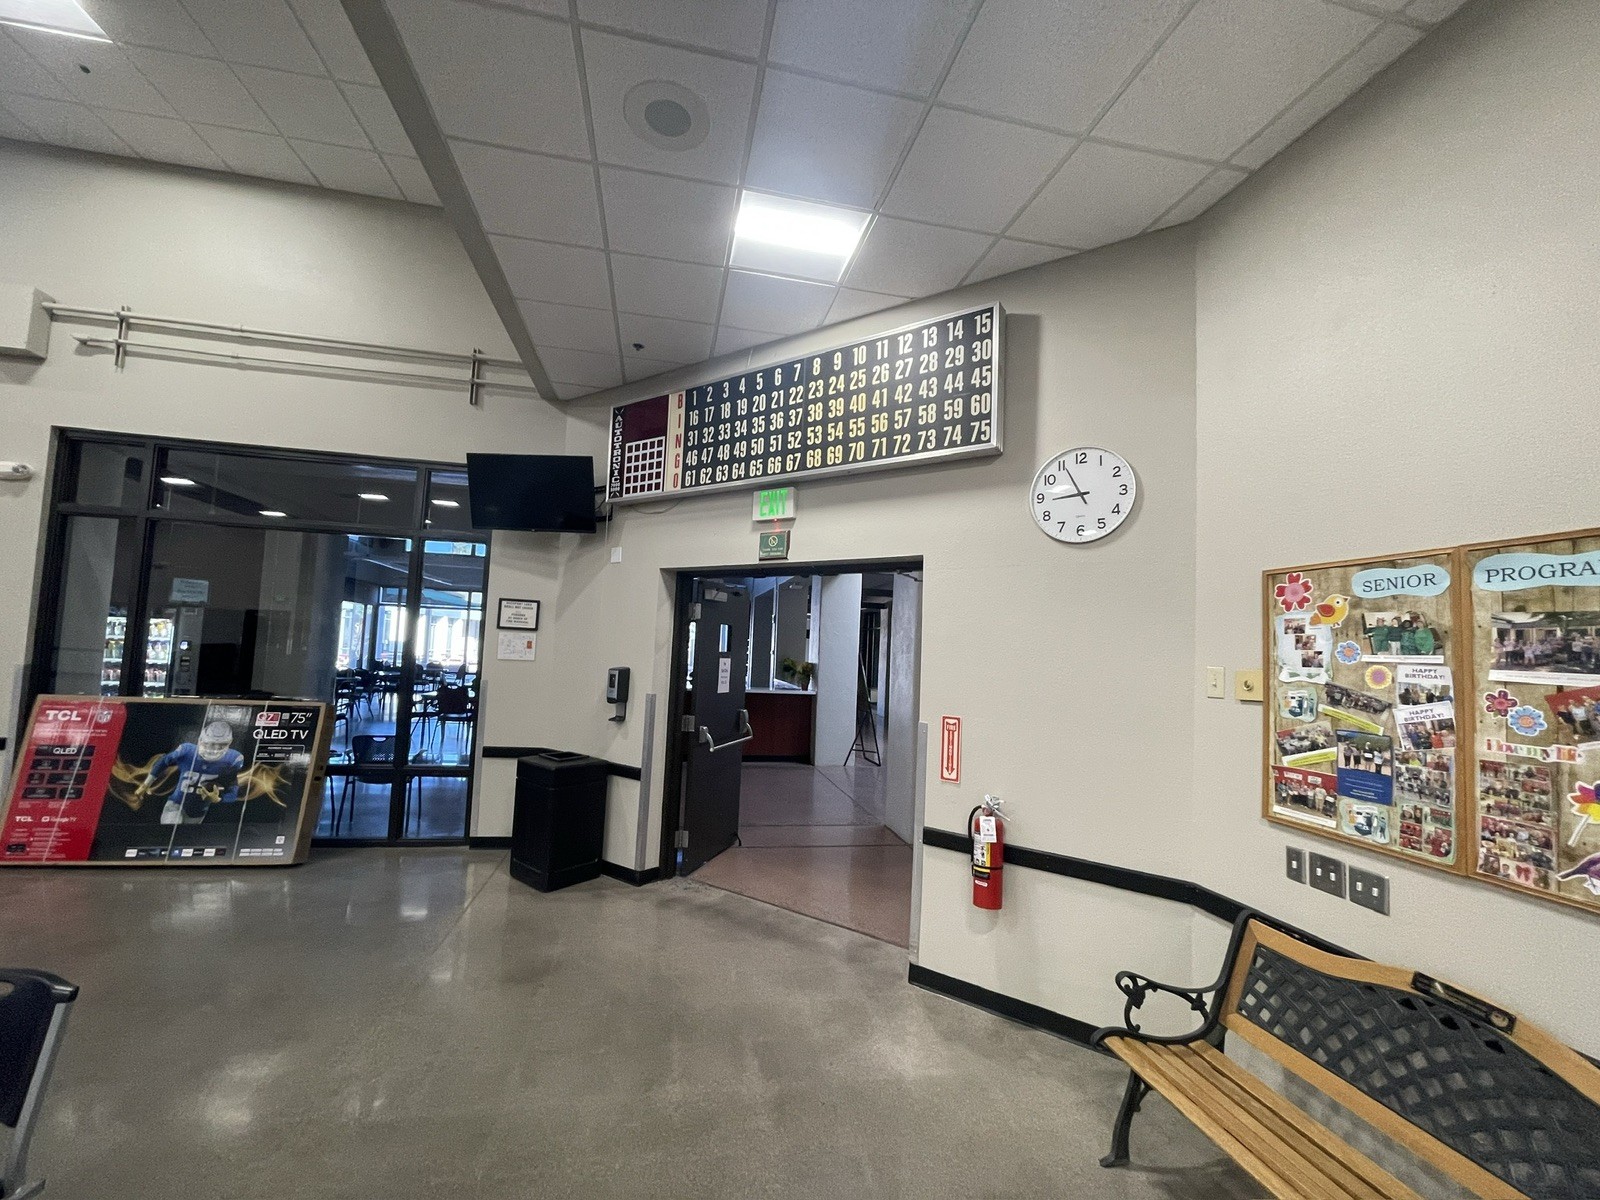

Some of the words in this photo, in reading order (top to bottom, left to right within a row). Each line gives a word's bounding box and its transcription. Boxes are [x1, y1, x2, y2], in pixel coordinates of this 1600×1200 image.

[693, 390, 697, 406] 1
[707, 386, 712, 402] 2
[723, 382, 728, 398] 3
[739, 378, 745, 393] 4
[756, 373, 762, 390] 5
[775, 368, 782, 386] 6
[794, 363, 801, 381] 7
[813, 358, 821, 376] 8
[834, 352, 842, 371] 9
[853, 345, 866, 365] 10
[876, 340, 888, 360] 11
[898, 333, 913, 355] 12
[922, 326, 937, 348] 13
[947, 320, 963, 342] 14
[974, 313, 990, 335] 15
[690, 410, 698, 425] 16
[705, 406, 714, 422] 17
[721, 402, 730, 419] 18
[737, 398, 747, 416] 19
[752, 394, 766, 412] 20
[771, 390, 784, 408] 21
[789, 386, 804, 405] 22
[808, 380, 824, 399] 23
[828, 374, 845, 395] 24
[850, 369, 866, 390] 25
[872, 363, 889, 384] 26
[895, 357, 913, 380] 27
[919, 351, 938, 374] 28
[944, 345, 964, 368] 29
[972, 339, 991, 362] 30
[688, 430, 697, 446] 31
[703, 427, 714, 443] 32
[718, 423, 730, 440] 33
[735, 420, 747, 437] 34
[752, 416, 765, 434] 35
[770, 412, 784, 431] 36
[789, 408, 803, 427] 37
[808, 402, 823, 422] 38
[828, 398, 844, 418] 39
[849, 393, 866, 413] 40
[872, 388, 888, 408] 41
[894, 383, 912, 403] 42
[918, 377, 938, 399] 43
[944, 371, 964, 393] 44
[971, 365, 991, 388] 45
[686, 450, 697, 466] 46
[702, 447, 713, 463] 47
[718, 444, 730, 460] 48
[734, 441, 746, 458] 49
[751, 438, 764, 455] 50
[770, 434, 782, 452] 51
[788, 431, 802, 449] 52
[807, 426, 822, 445] 53
[828, 422, 843, 441] 54
[849, 417, 865, 437] 55
[871, 412, 888, 434] 56
[894, 408, 912, 430] 57
[918, 403, 936, 425] 58
[944, 398, 963, 420] 59
[971, 393, 990, 416] 60
[685, 470, 695, 486] 61
[700, 468, 712, 484] 62
[716, 465, 728, 482] 63
[732, 462, 745, 479] 64
[750, 459, 763, 476] 65
[768, 456, 781, 474] 66
[786, 453, 801, 471] 67
[807, 449, 821, 468] 68
[827, 445, 842, 465] 69
[849, 441, 864, 461] 70
[872, 437, 886, 458] 71
[893, 434, 911, 454] 72
[918, 429, 936, 450] 73
[944, 425, 962, 446] 74
[971, 420, 990, 442] 75
[1076, 452, 1087, 464] 12
[1059, 460, 1065, 471] 11
[1100, 455, 1102, 466] 1
[1113, 466, 1121, 477] 2
[1044, 474, 1056, 486] 10
[1119, 484, 1128, 495] 3
[760, 488, 788, 516] EXIT
[1037, 493, 1045, 503] 9
[1111, 503, 1120, 514] 4
[1043, 511, 1051, 521] 8
[1057, 522, 1065, 532] 7
[1097, 518, 1106, 529] 5
[1077, 525, 1085, 536] 6
[1485, 560, 1600, 583] PROGRA
[1362, 572, 1437, 593] SENIOR
[46, 710, 81, 721] TCL
[253, 729, 288, 739] QLED
[290, 730, 309, 739] TV
[53, 747, 77, 755] QLED
